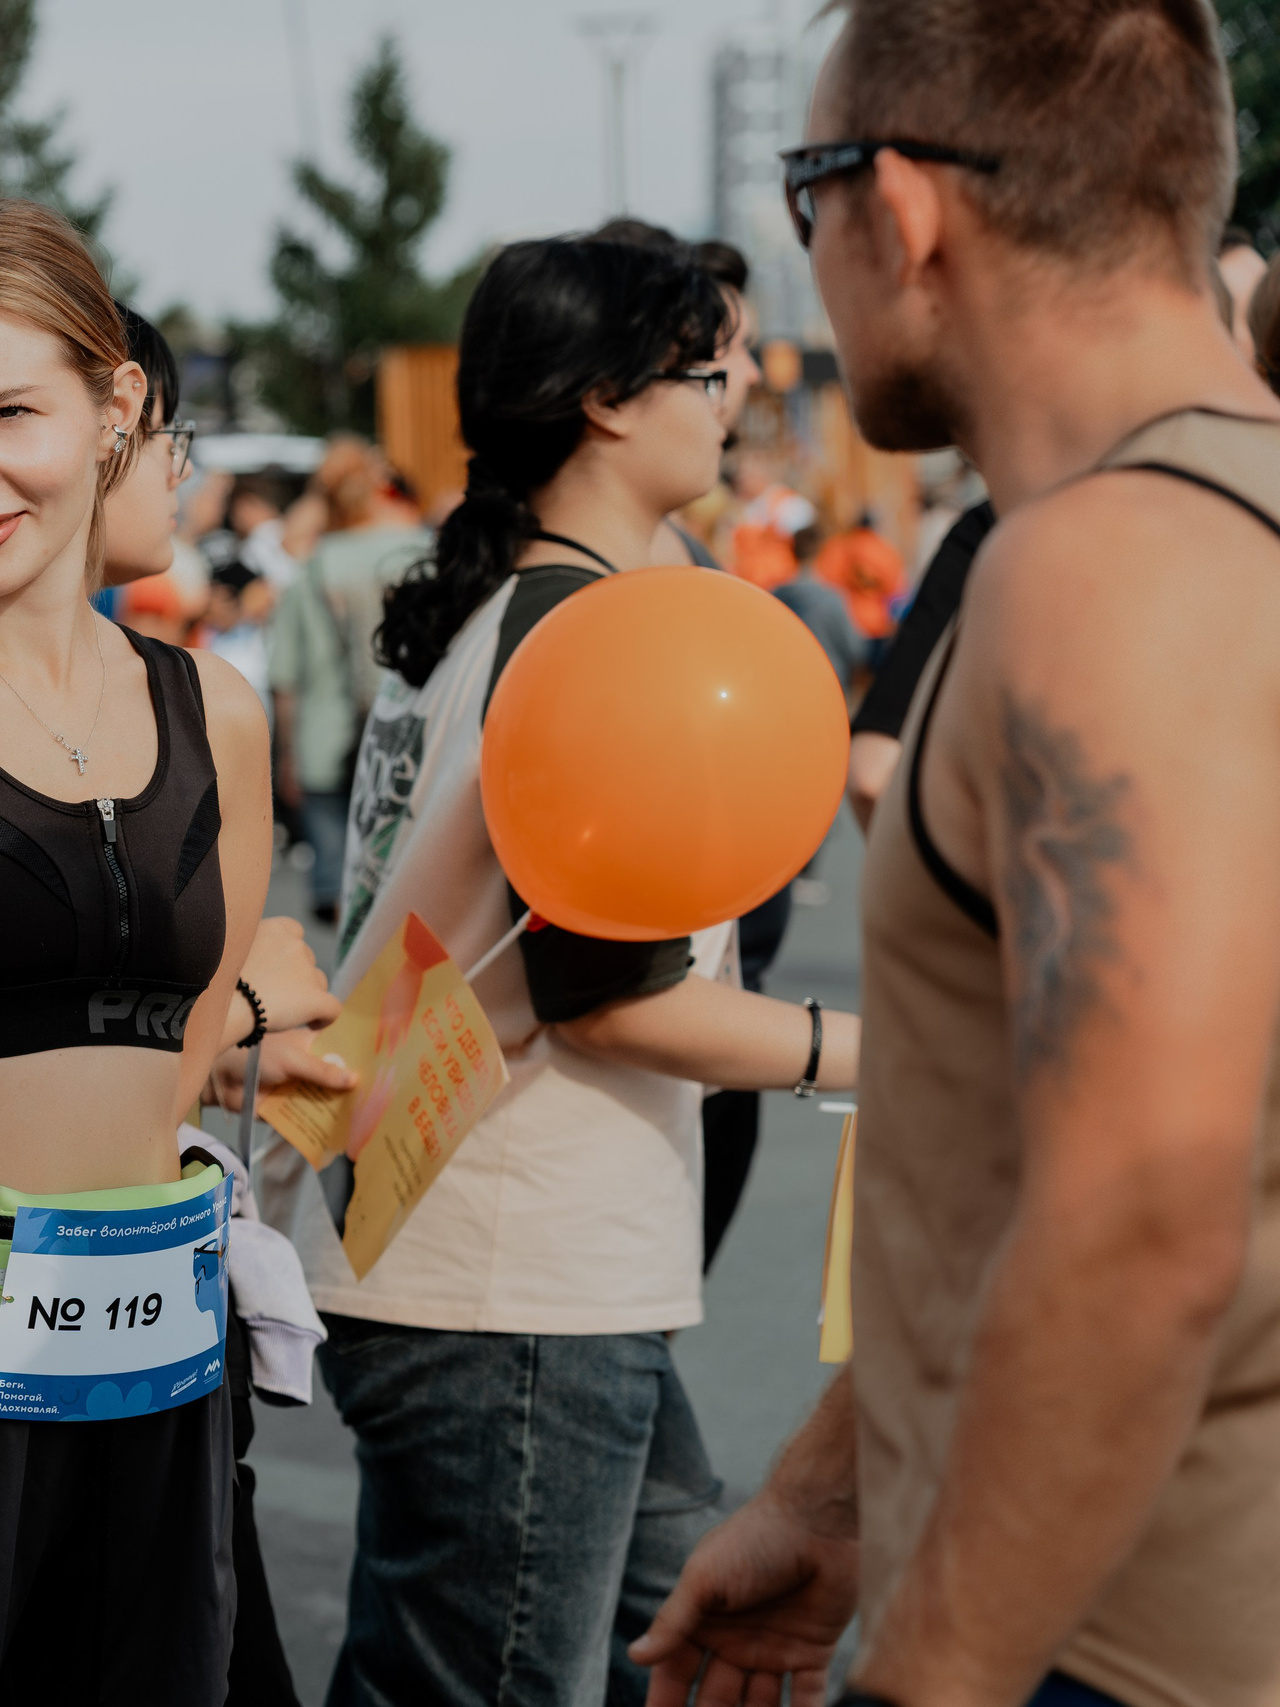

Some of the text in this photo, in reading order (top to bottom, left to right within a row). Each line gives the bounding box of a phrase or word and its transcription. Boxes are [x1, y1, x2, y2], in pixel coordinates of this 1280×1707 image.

[56, 1225, 97, 1237] Забег
[100, 1217, 177, 1238] волонтёров
[179, 1208, 211, 1227] Южного
[28, 1292, 163, 1331] № 119
